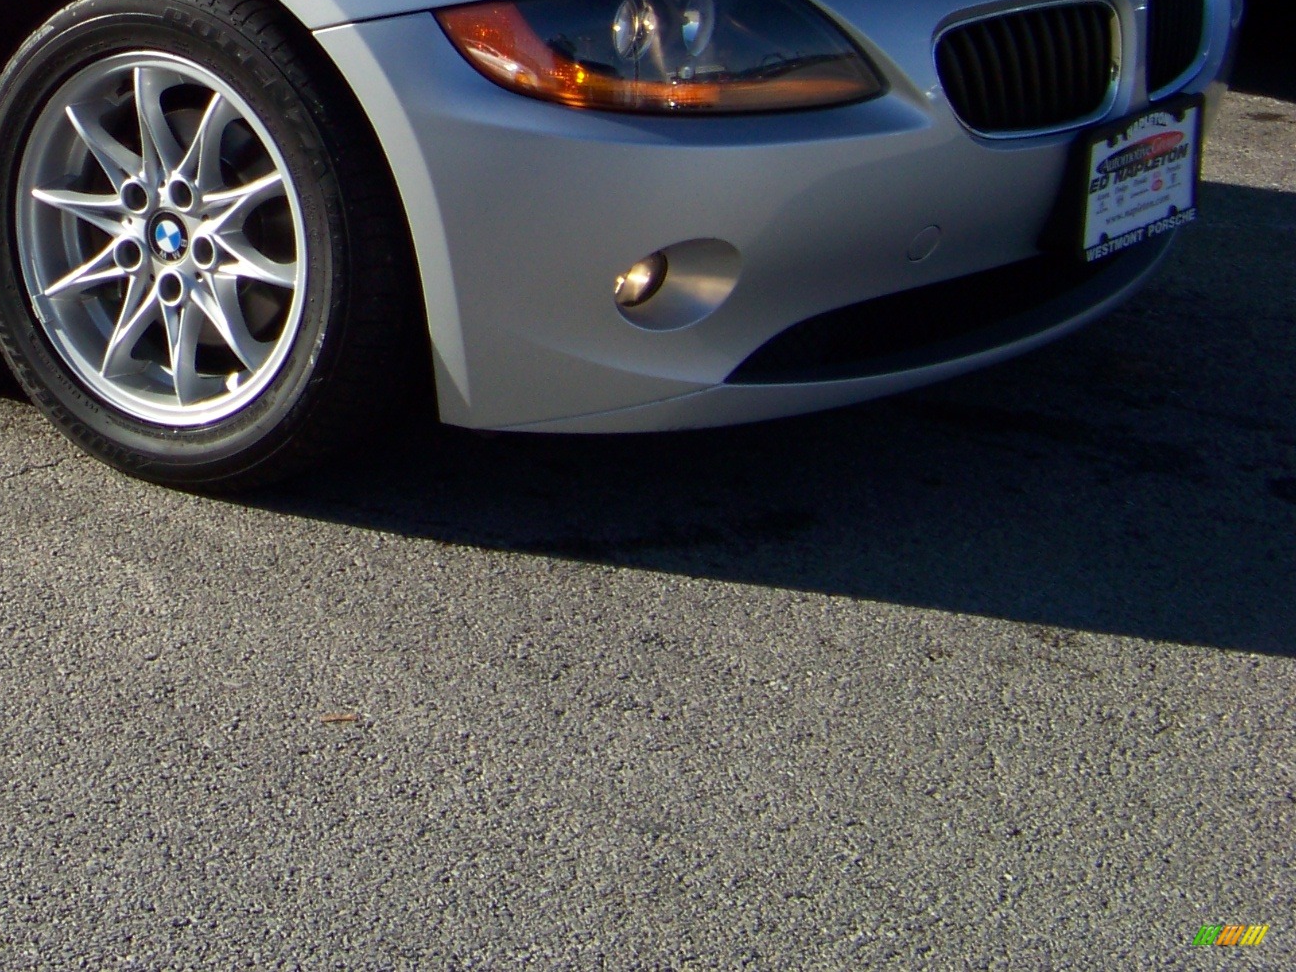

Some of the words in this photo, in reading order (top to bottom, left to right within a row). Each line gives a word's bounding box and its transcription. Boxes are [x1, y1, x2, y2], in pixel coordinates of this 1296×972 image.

[1088, 173, 1110, 196] ED
[1113, 142, 1189, 183] NAPLETON
[1085, 228, 1144, 263] WESTMONT
[1147, 207, 1198, 237] PORSCHE
